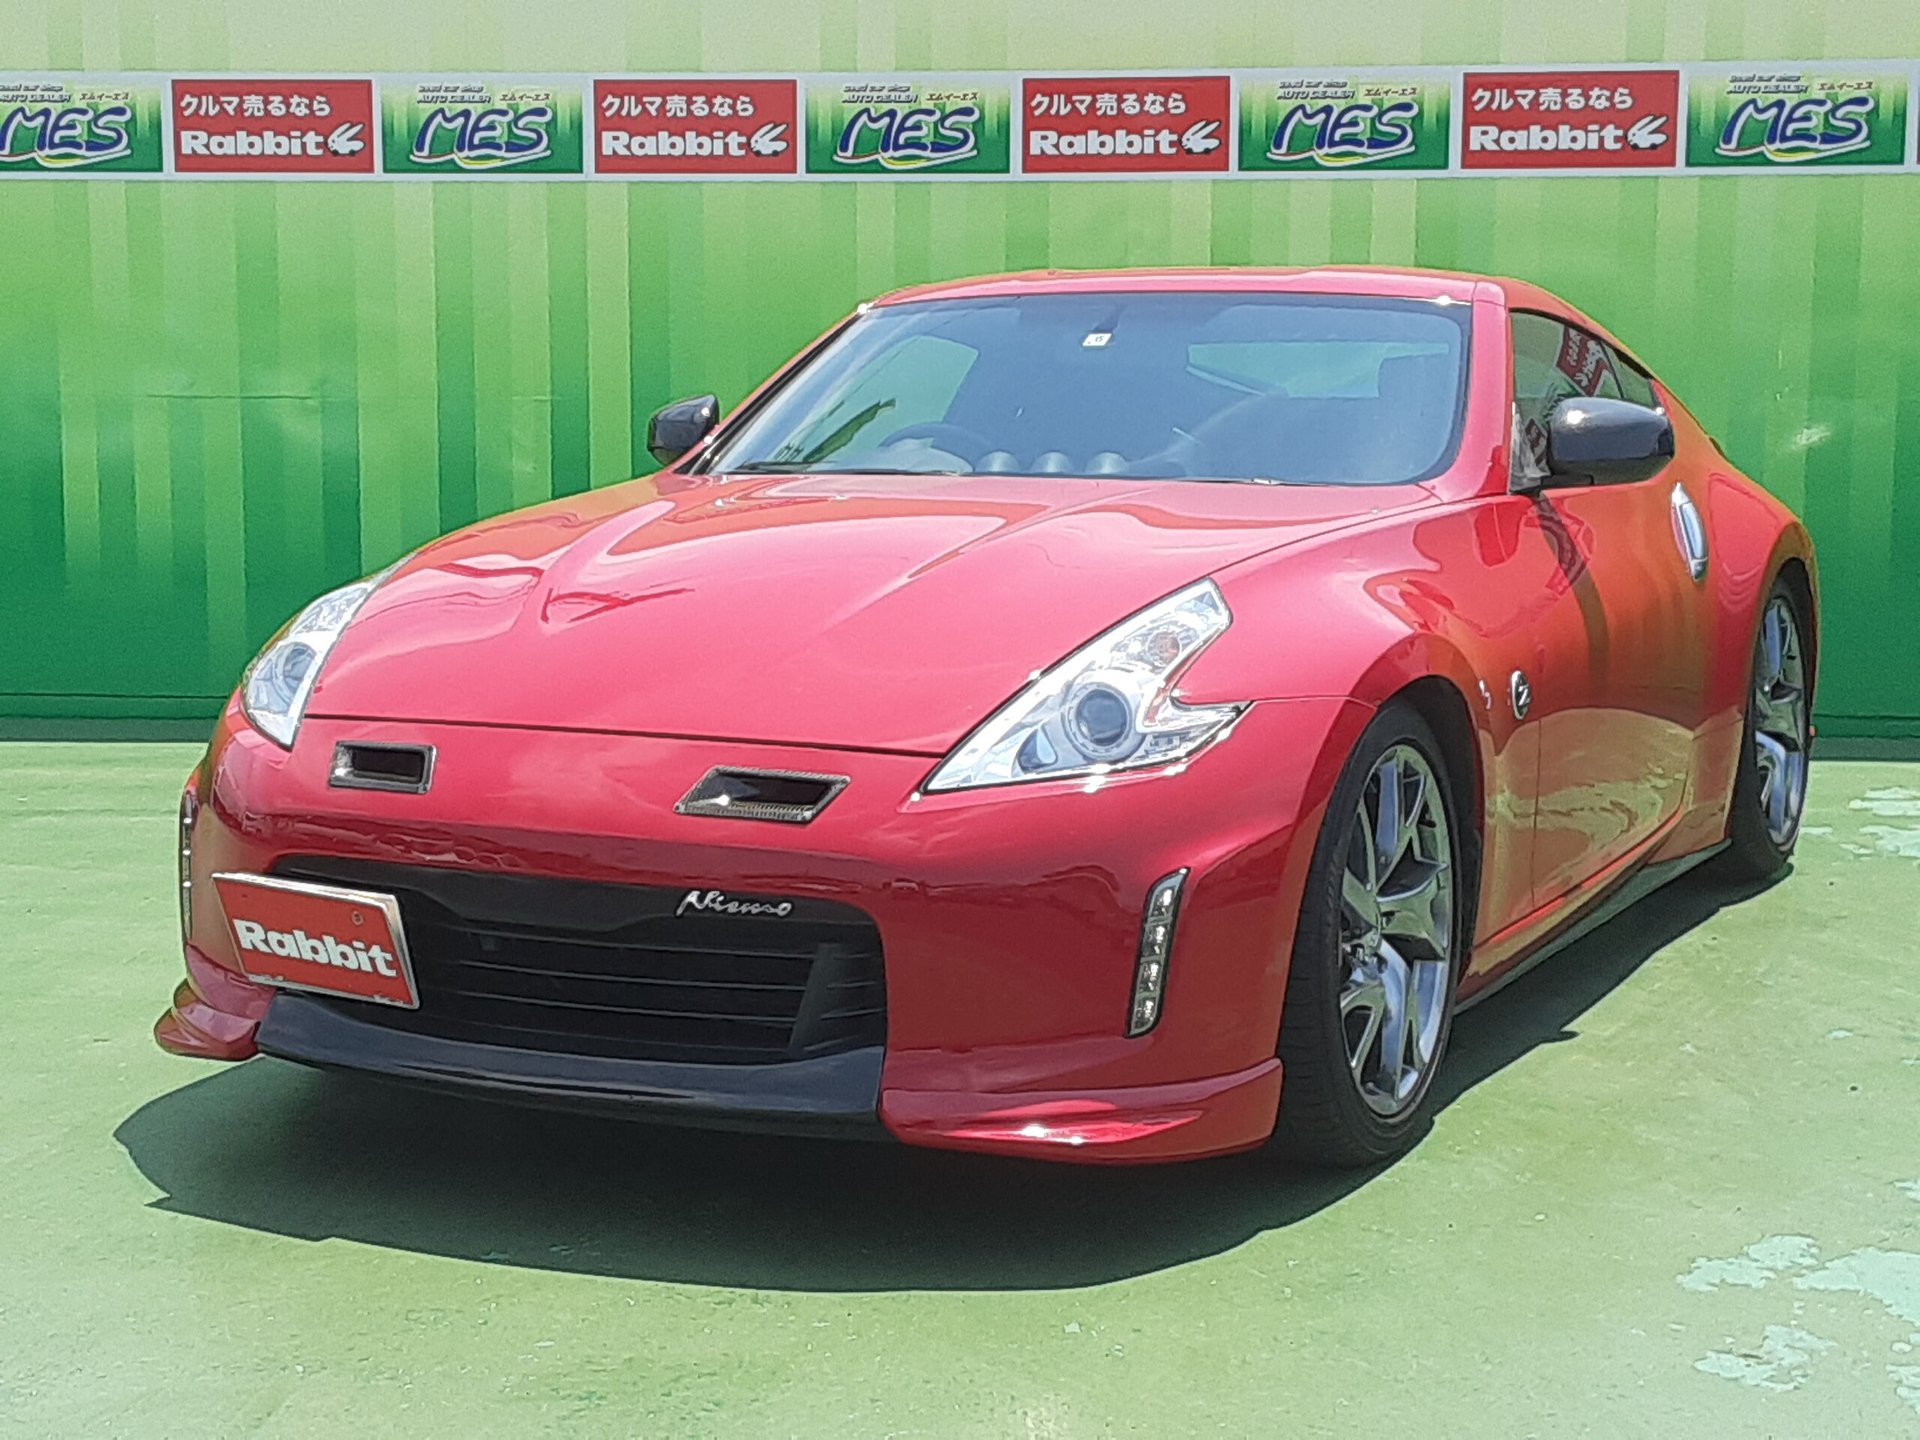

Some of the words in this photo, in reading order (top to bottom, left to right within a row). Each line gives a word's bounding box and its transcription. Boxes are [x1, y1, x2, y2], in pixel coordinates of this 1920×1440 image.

[179, 94, 331, 117] クルマ売るなら
[601, 94, 755, 118] クルマ売るなら
[1030, 92, 1186, 117] クルマ売るなら
[1471, 86, 1633, 112] クルマ売るなら
[0, 105, 131, 152] MES
[414, 106, 552, 154] MES
[838, 106, 980, 154] MES
[1272, 101, 1419, 151] MES
[1719, 95, 1875, 146] MES
[180, 130, 325, 156] Rabbit
[601, 130, 748, 157] Rabbit
[1029, 128, 1180, 156] Rabbit
[1469, 123, 1625, 151] Rabbit
[232, 918, 397, 977] Rabbit
